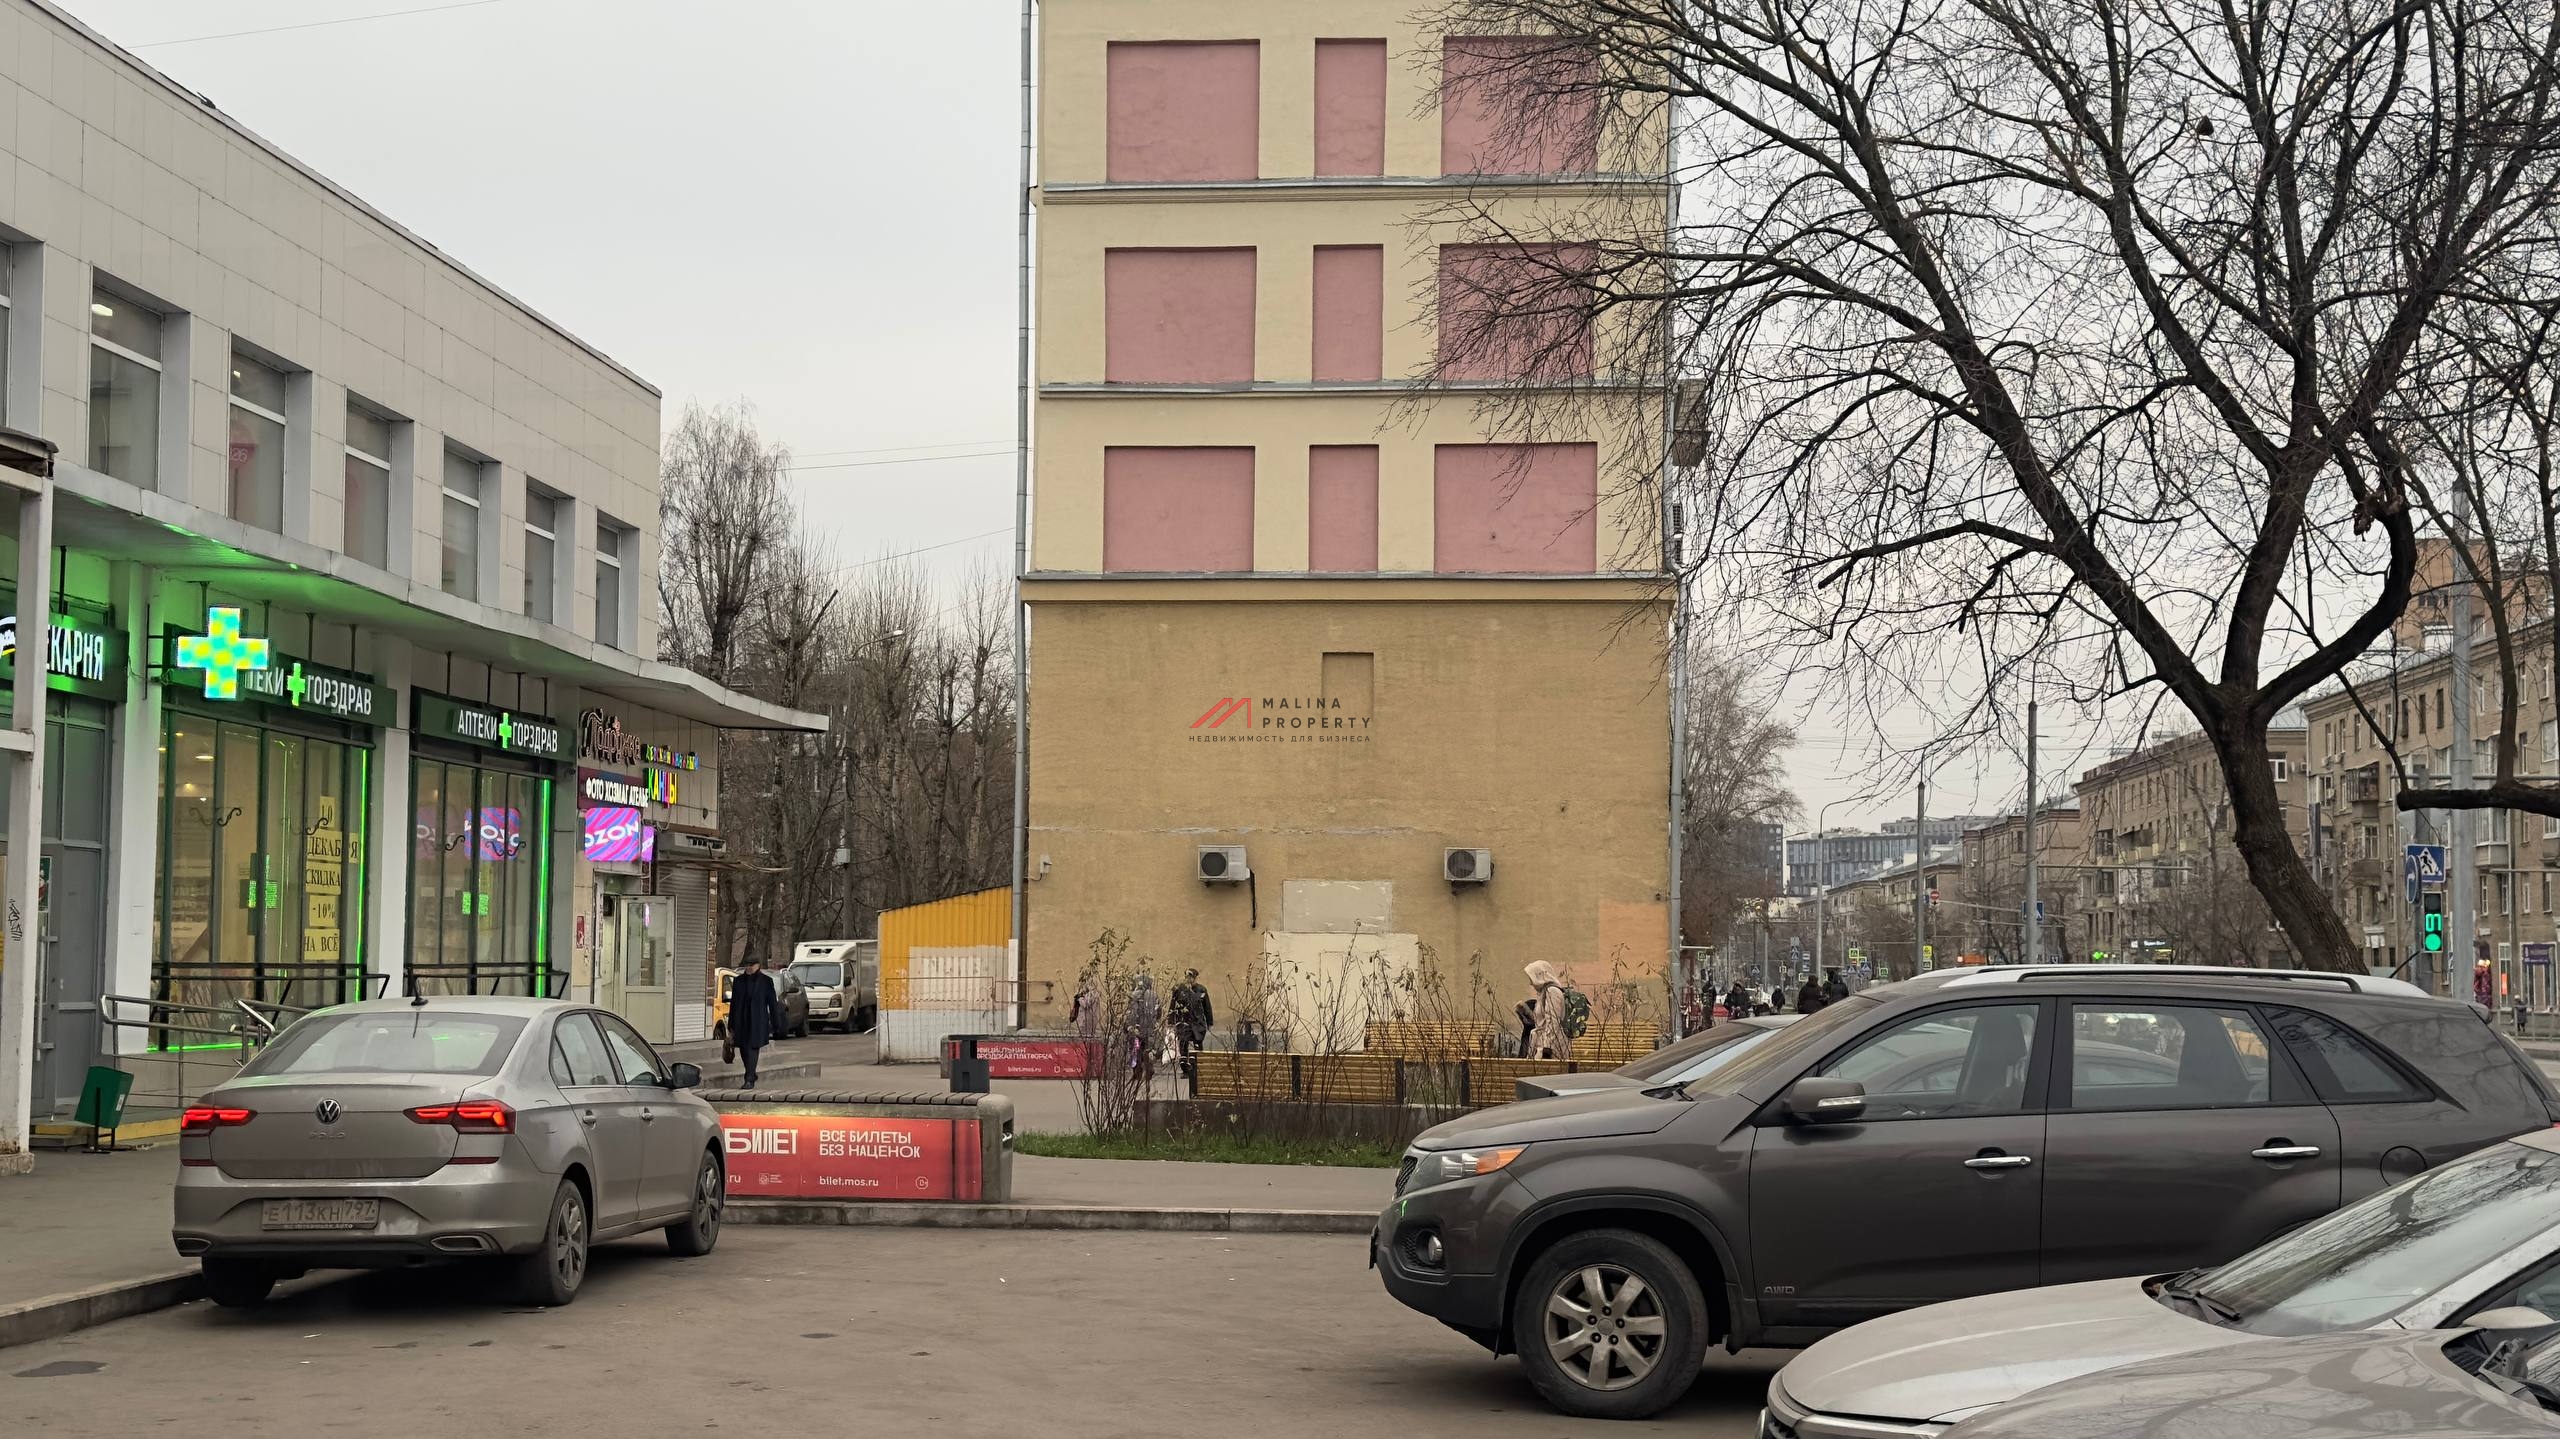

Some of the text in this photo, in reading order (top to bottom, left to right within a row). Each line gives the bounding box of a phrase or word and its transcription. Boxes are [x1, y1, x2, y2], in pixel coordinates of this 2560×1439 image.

[47, 624, 104, 681] КАРНЯ
[307, 674, 372, 716] ГОРЗДРАВ
[458, 709, 558, 754] АПТЕКИ ГОРЗДРАВ
[585, 776, 604, 801] ФОТО
[604, 780, 629, 804] ХОЗМАГ
[647, 767, 677, 808] КАНЦЫ
[584, 820, 639, 848] OZON
[307, 835, 358, 859] ДЕКАБЯ
[305, 867, 341, 887] СКИДКА
[313, 904, 336, 920] -10%
[304, 933, 339, 952] НА ВСЁ
[819, 1129, 911, 1144] ВСЕ БИЛЕТЫ
[819, 1144, 921, 1159] БЕЗ НАЦЕНОК
[819, 1175, 879, 1187] bilet.mos.ru
[344, 1200, 374, 1217] 797
[1763, 1285, 1796, 1295] AWD
